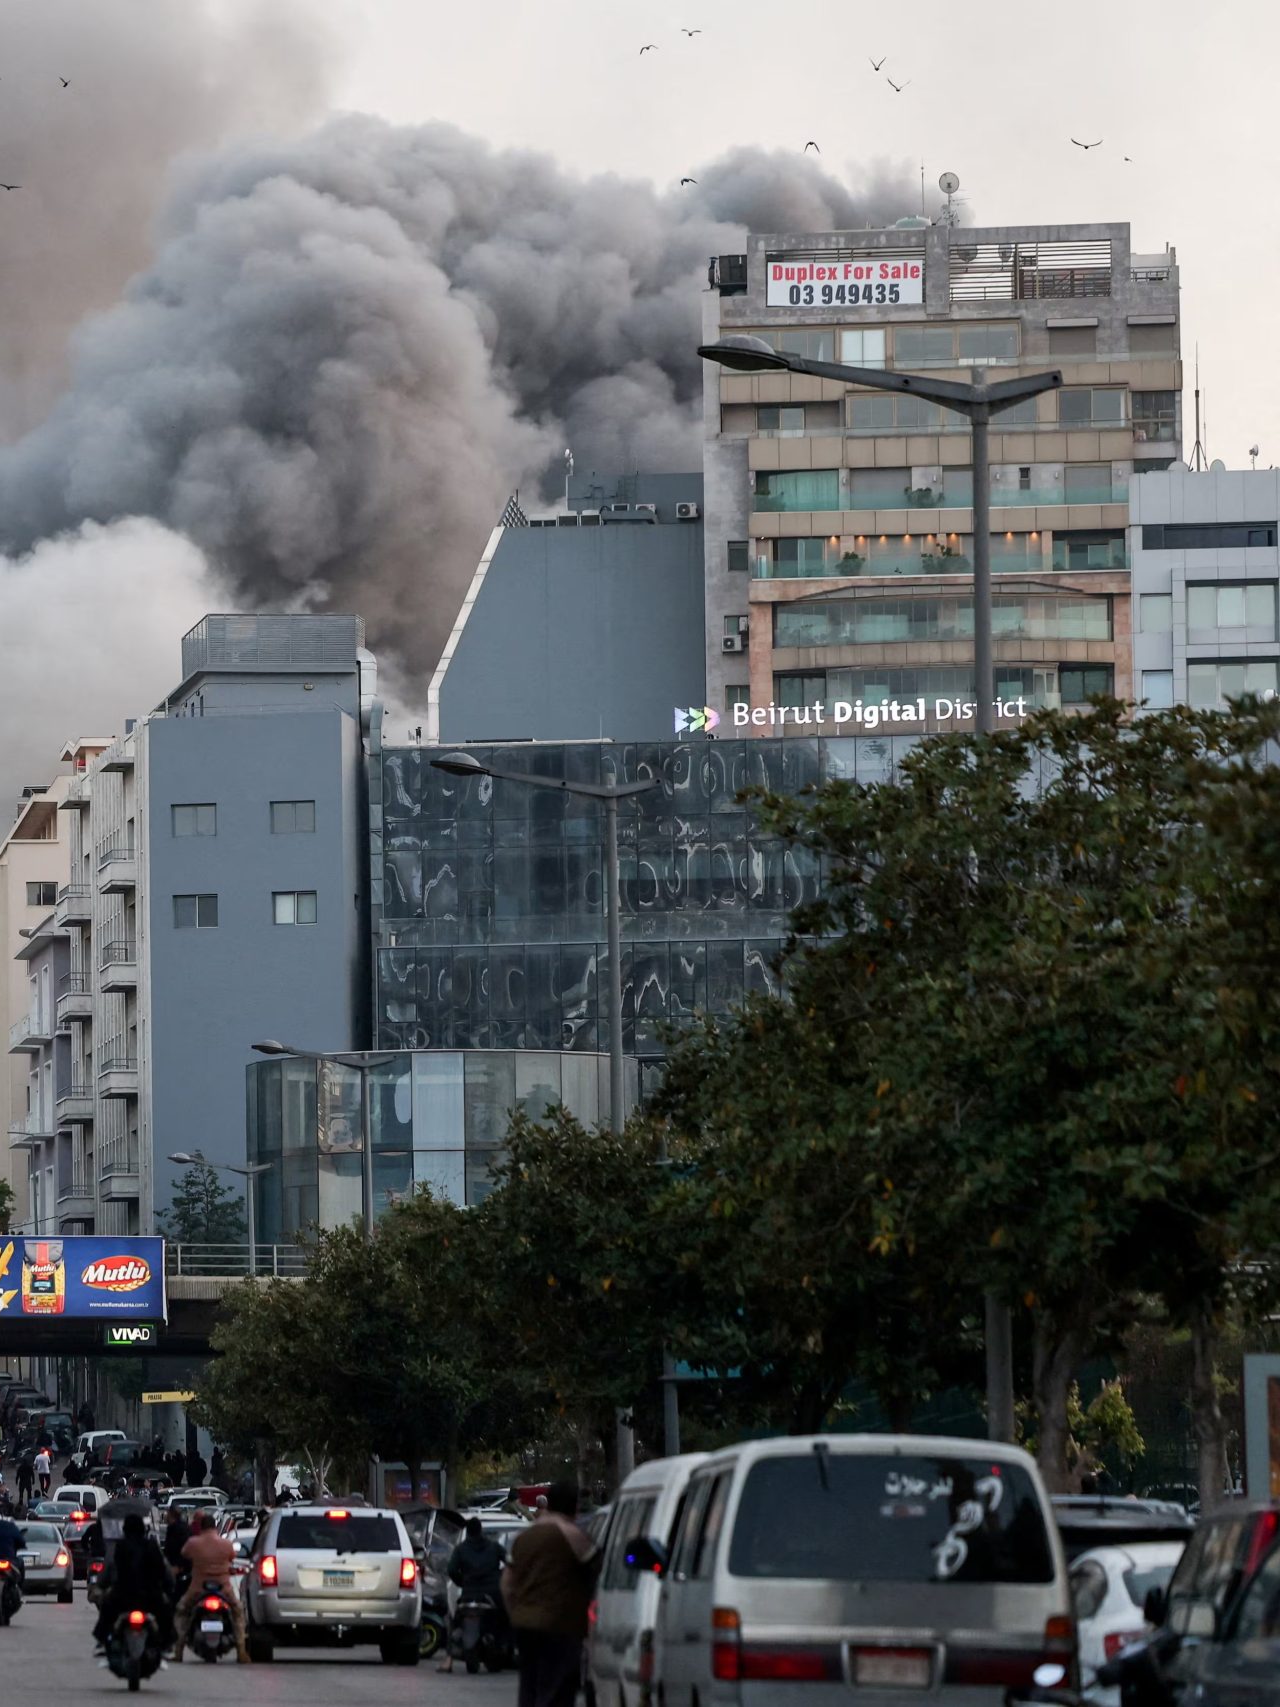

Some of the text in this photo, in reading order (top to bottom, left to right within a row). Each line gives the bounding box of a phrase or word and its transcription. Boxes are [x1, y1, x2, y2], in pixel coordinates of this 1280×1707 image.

[772, 262, 920, 284] Duplex For Sale
[789, 283, 900, 305] 03 949435
[733, 696, 1027, 729] Beirut Digital Disict
[82, 1261, 146, 1283] Mutlu
